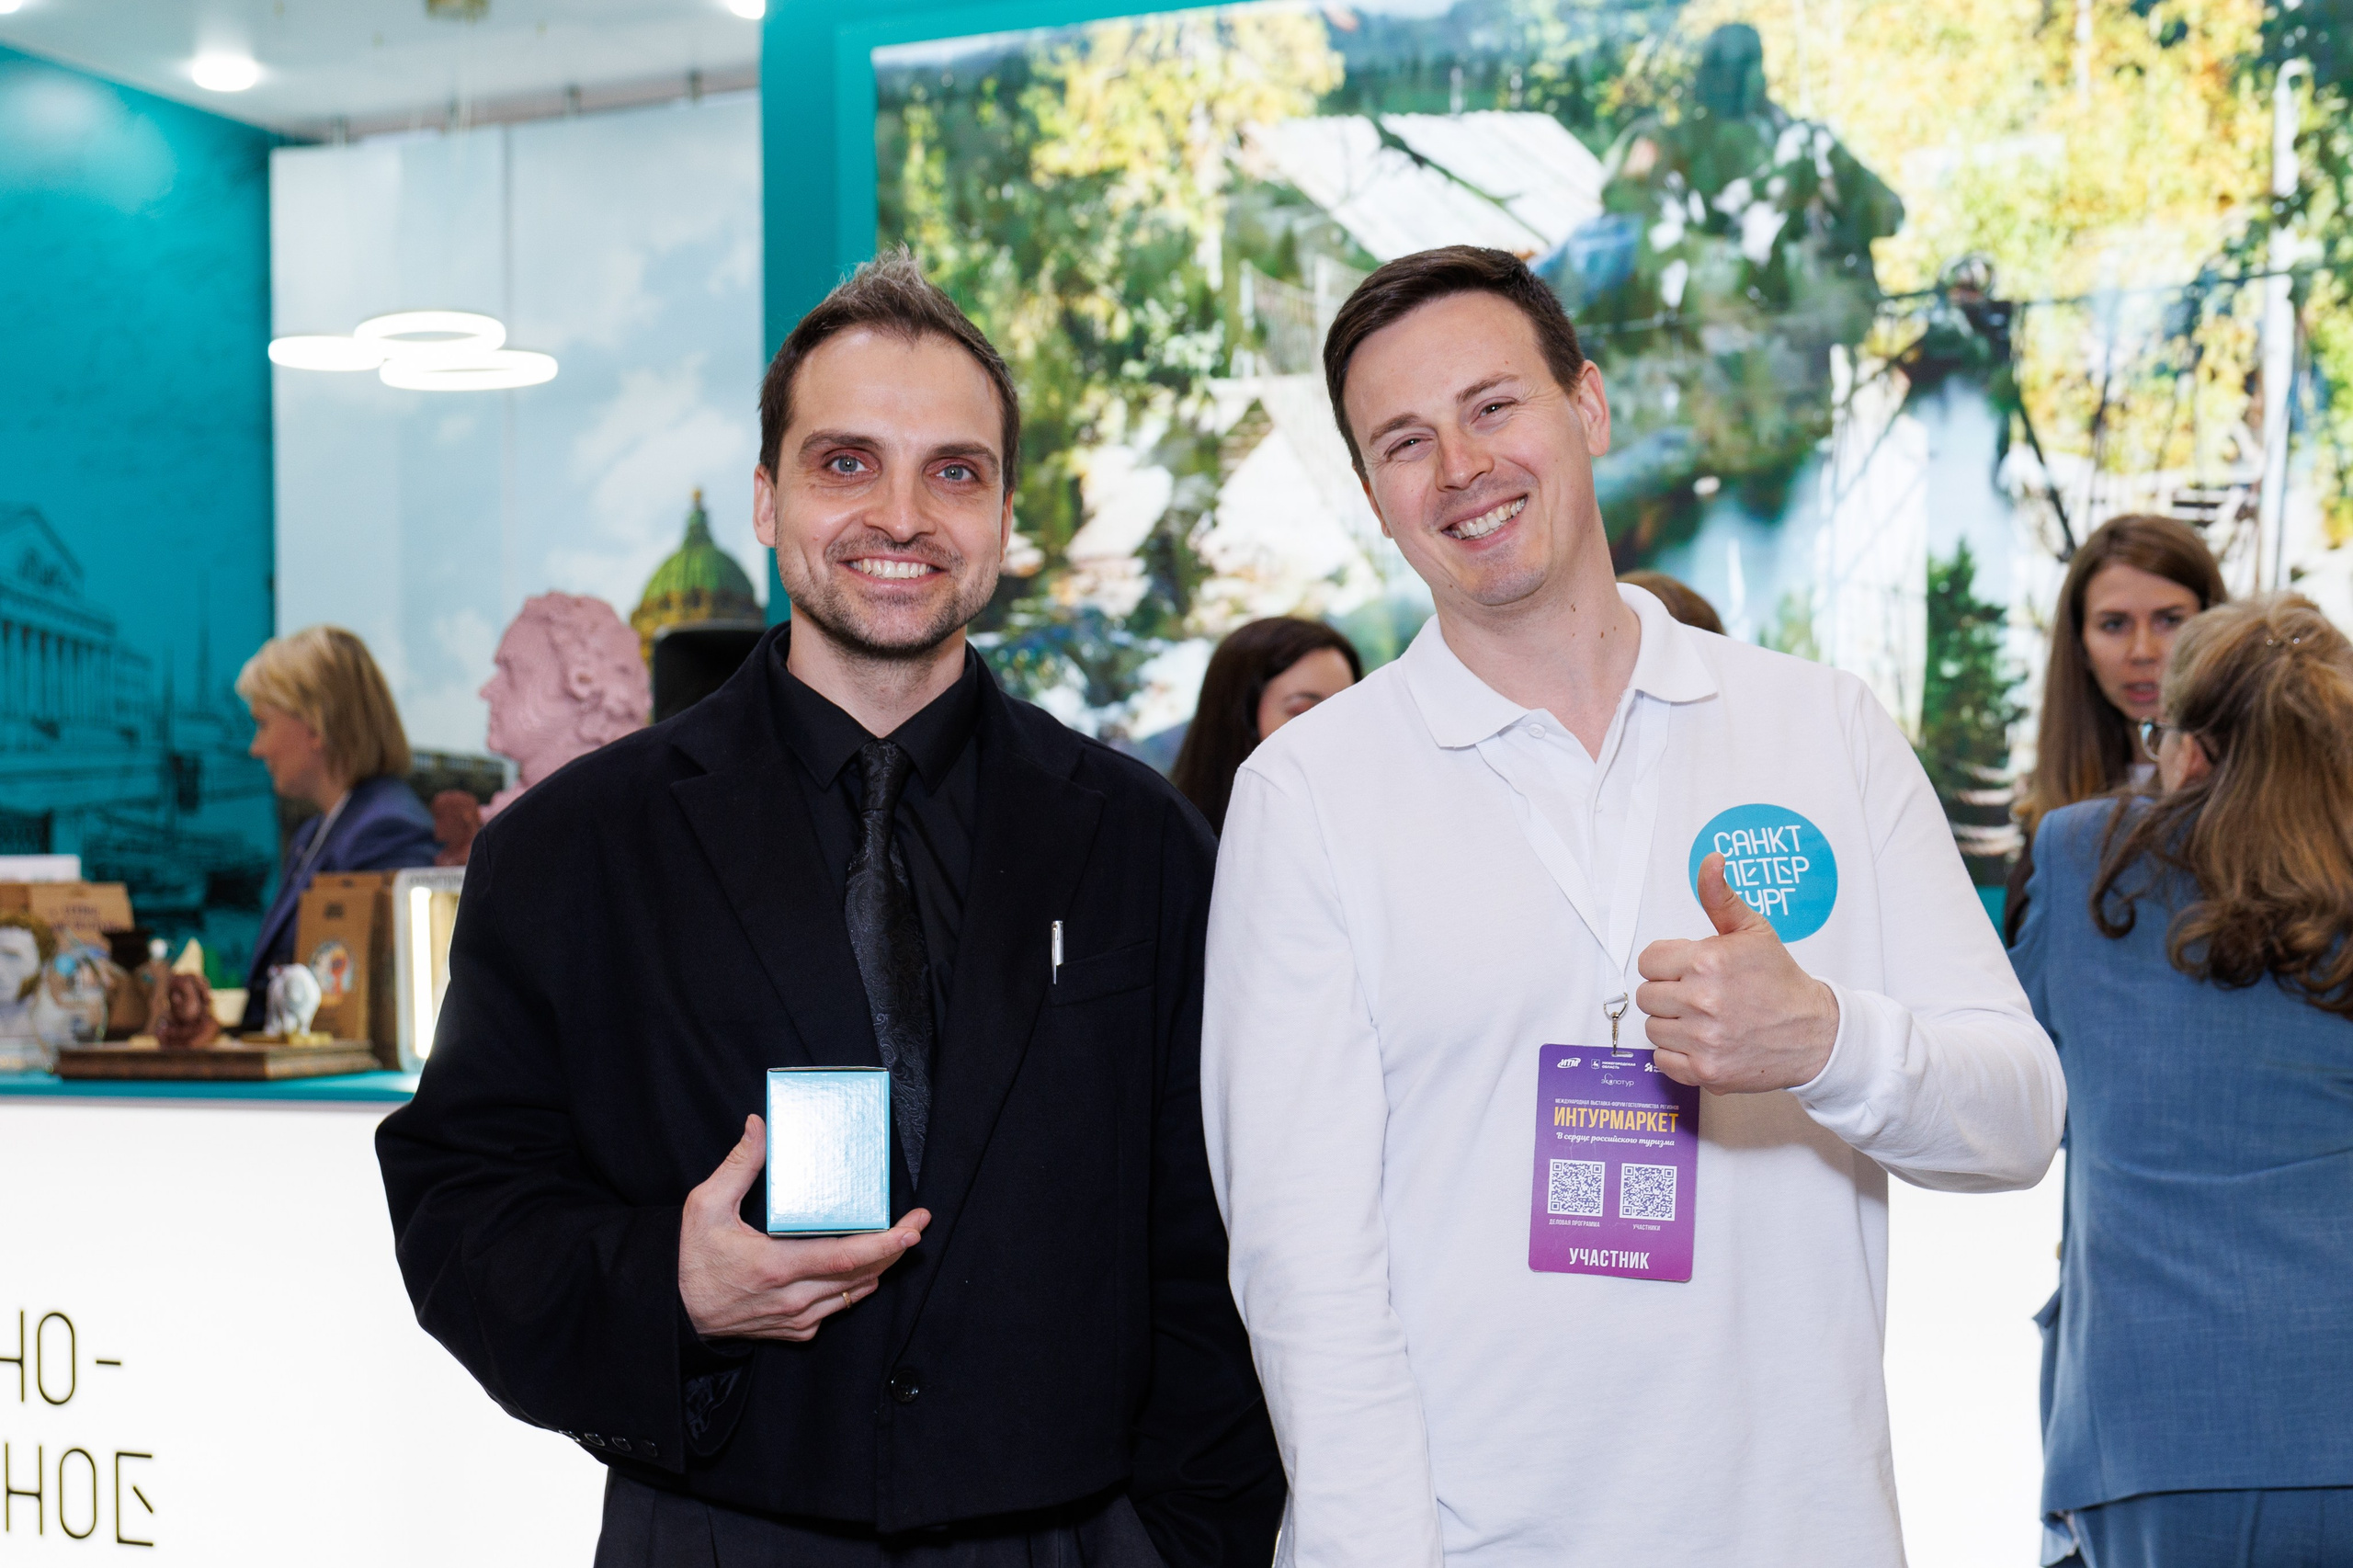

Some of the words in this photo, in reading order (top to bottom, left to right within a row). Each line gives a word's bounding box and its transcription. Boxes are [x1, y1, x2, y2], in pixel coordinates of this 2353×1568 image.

[1713, 824, 1802, 858] САНКТ
[1735, 888, 1796, 916] УРГ
[1559, 1058, 1580, 1068] ИТМ
[1553, 1106, 1679, 1133] ИНТУРМАРКЕТ
[1556, 1131, 1563, 1140] В
[1563, 1133, 1590, 1143] сердце
[1590, 1135, 1638, 1144] российского
[1638, 1139, 1675, 1148] туризма
[1549, 1218, 1572, 1226] ДЕЛОВАЯ
[1572, 1220, 1600, 1228] ПРОГРАММА
[1632, 1223, 1661, 1232] УЧАСТНИКИ
[1569, 1247, 1650, 1269] УЧАСТНИК
[5, 1441, 154, 1548] НОЕ
